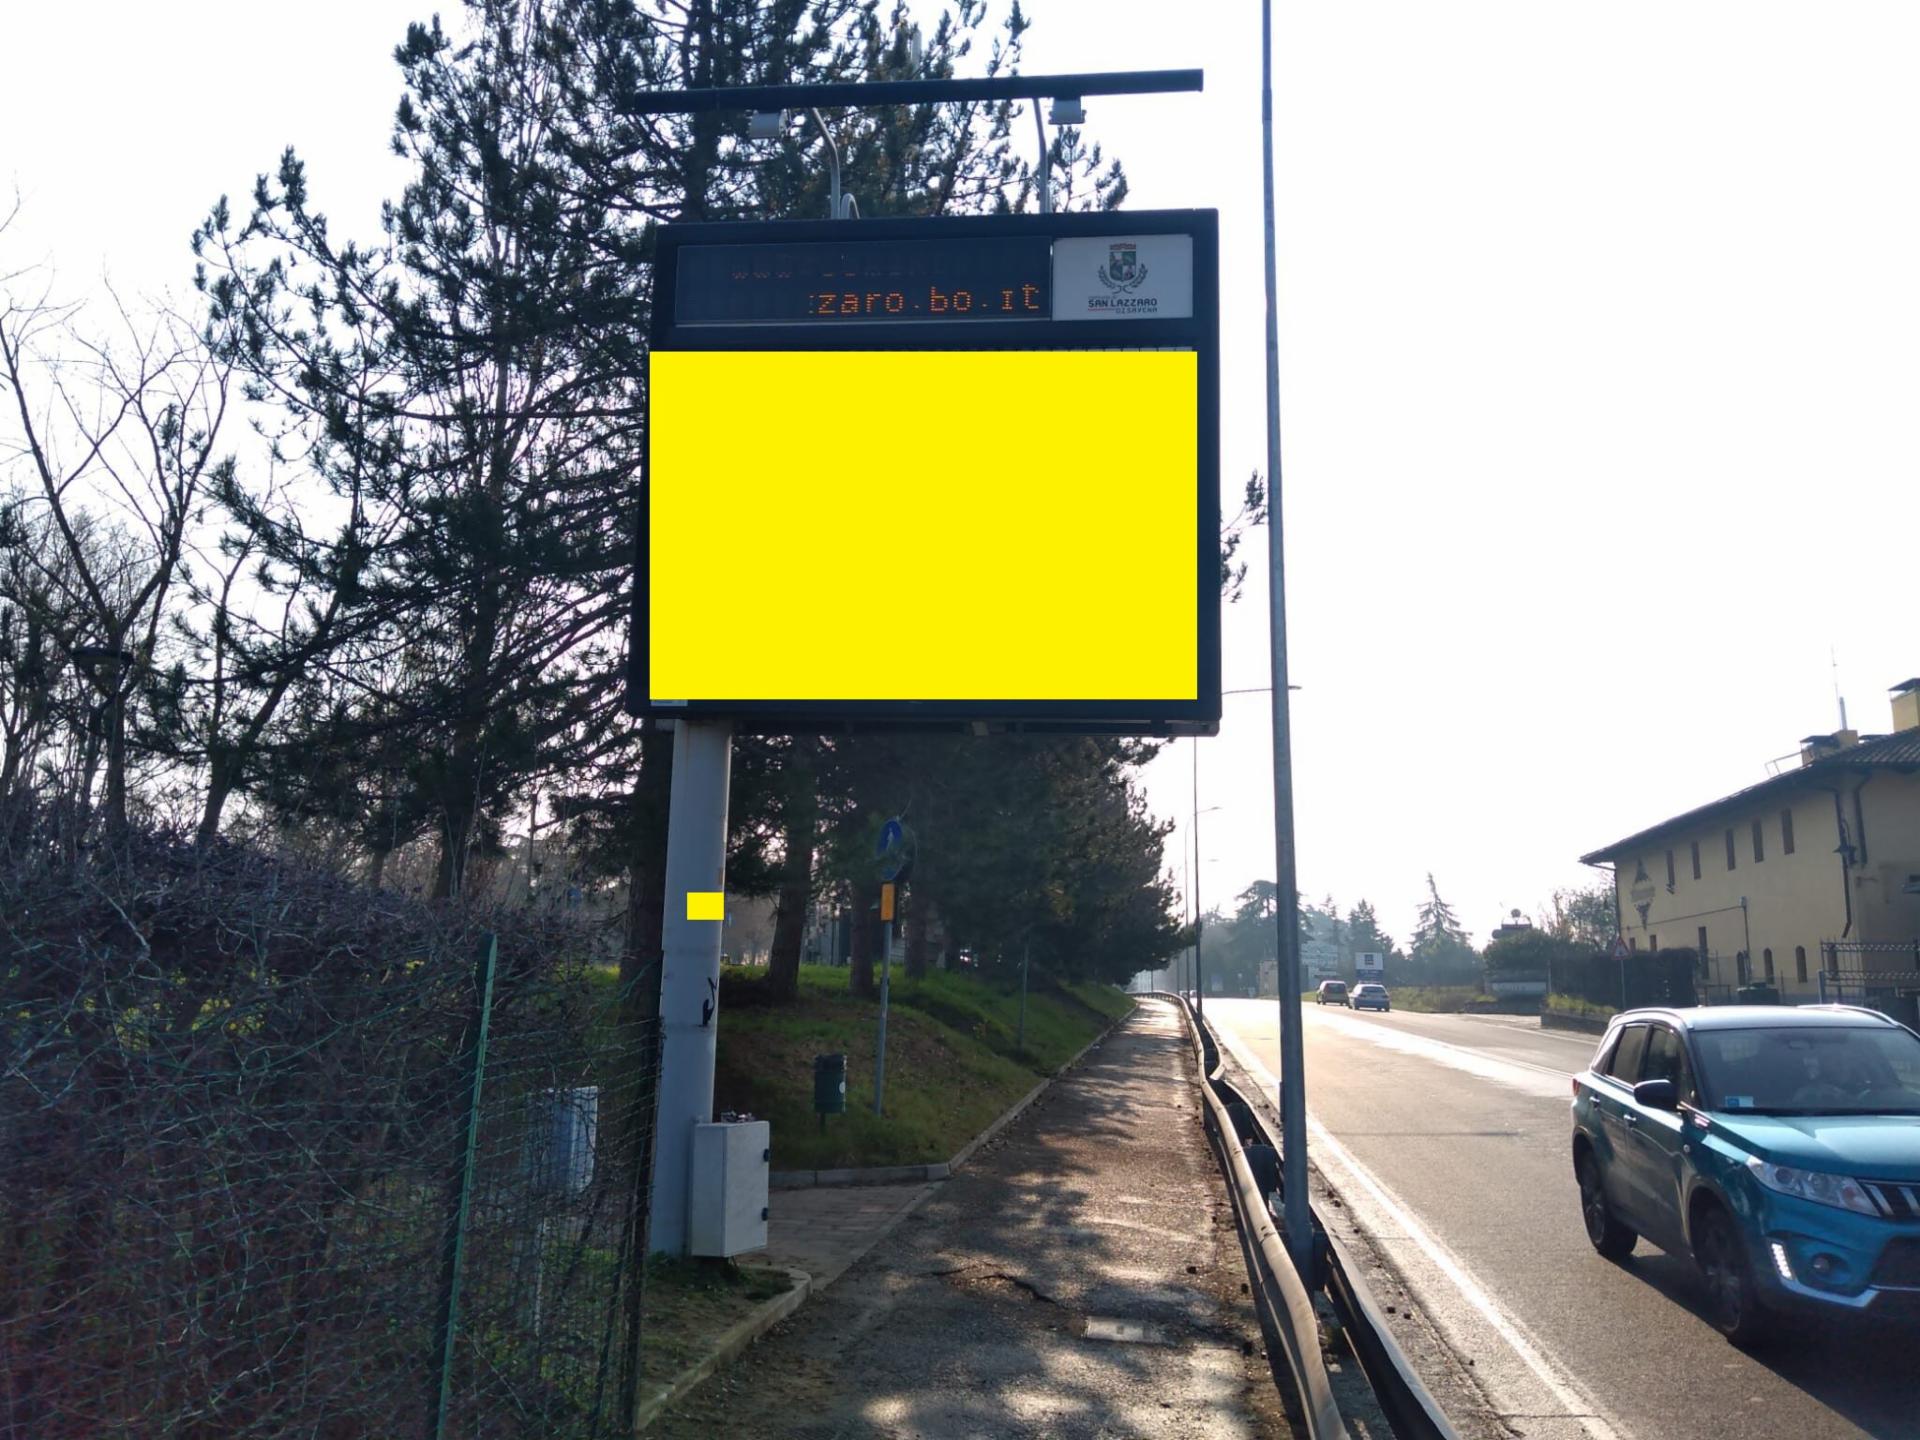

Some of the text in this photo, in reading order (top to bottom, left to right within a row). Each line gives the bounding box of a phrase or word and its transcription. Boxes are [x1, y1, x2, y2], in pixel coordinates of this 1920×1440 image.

[809, 284, 1040, 314] zaro.bo.it
[1087, 298, 1158, 308] SAN LAZZARO
